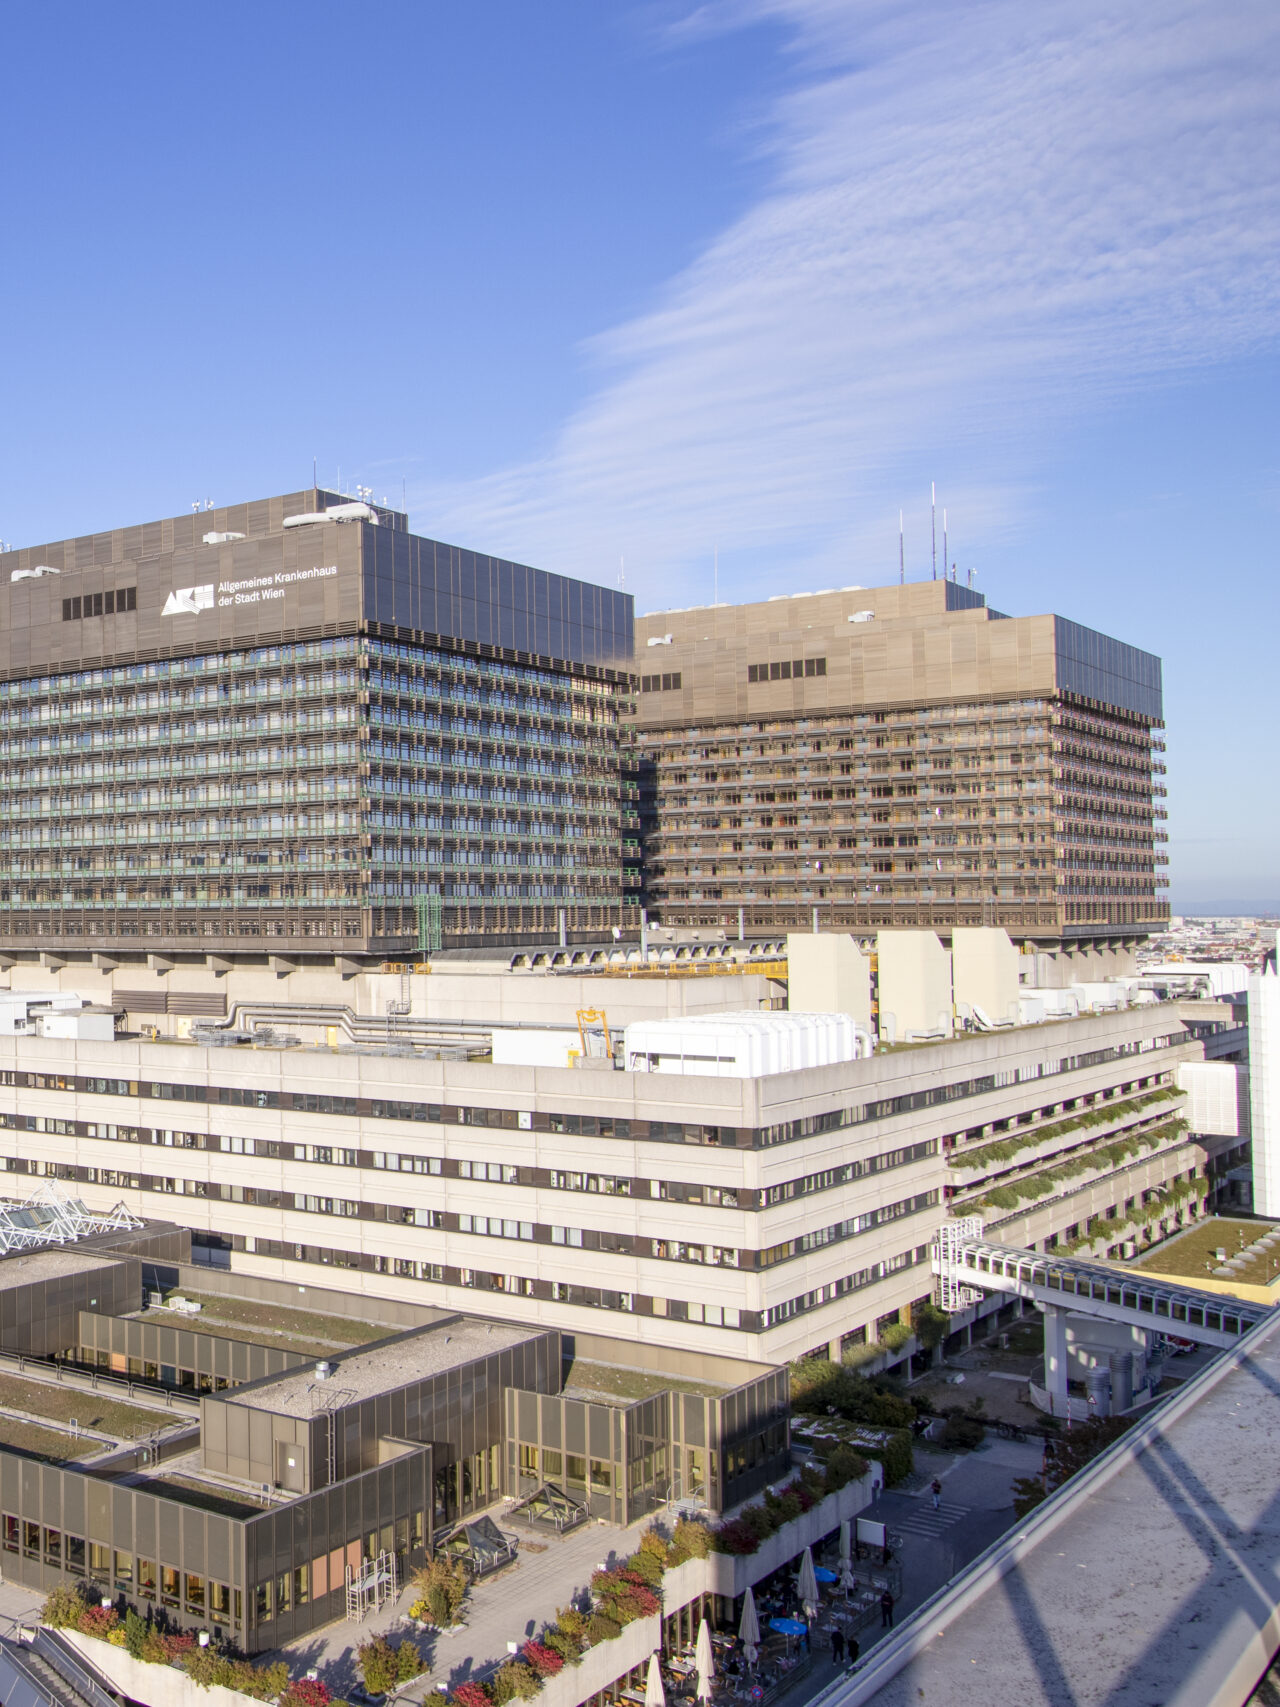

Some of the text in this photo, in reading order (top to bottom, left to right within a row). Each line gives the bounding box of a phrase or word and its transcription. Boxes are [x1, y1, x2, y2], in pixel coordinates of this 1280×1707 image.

[218, 566, 337, 593] Allgemeines Krankenhaus
[218, 588, 285, 606] der Stadt Wien
